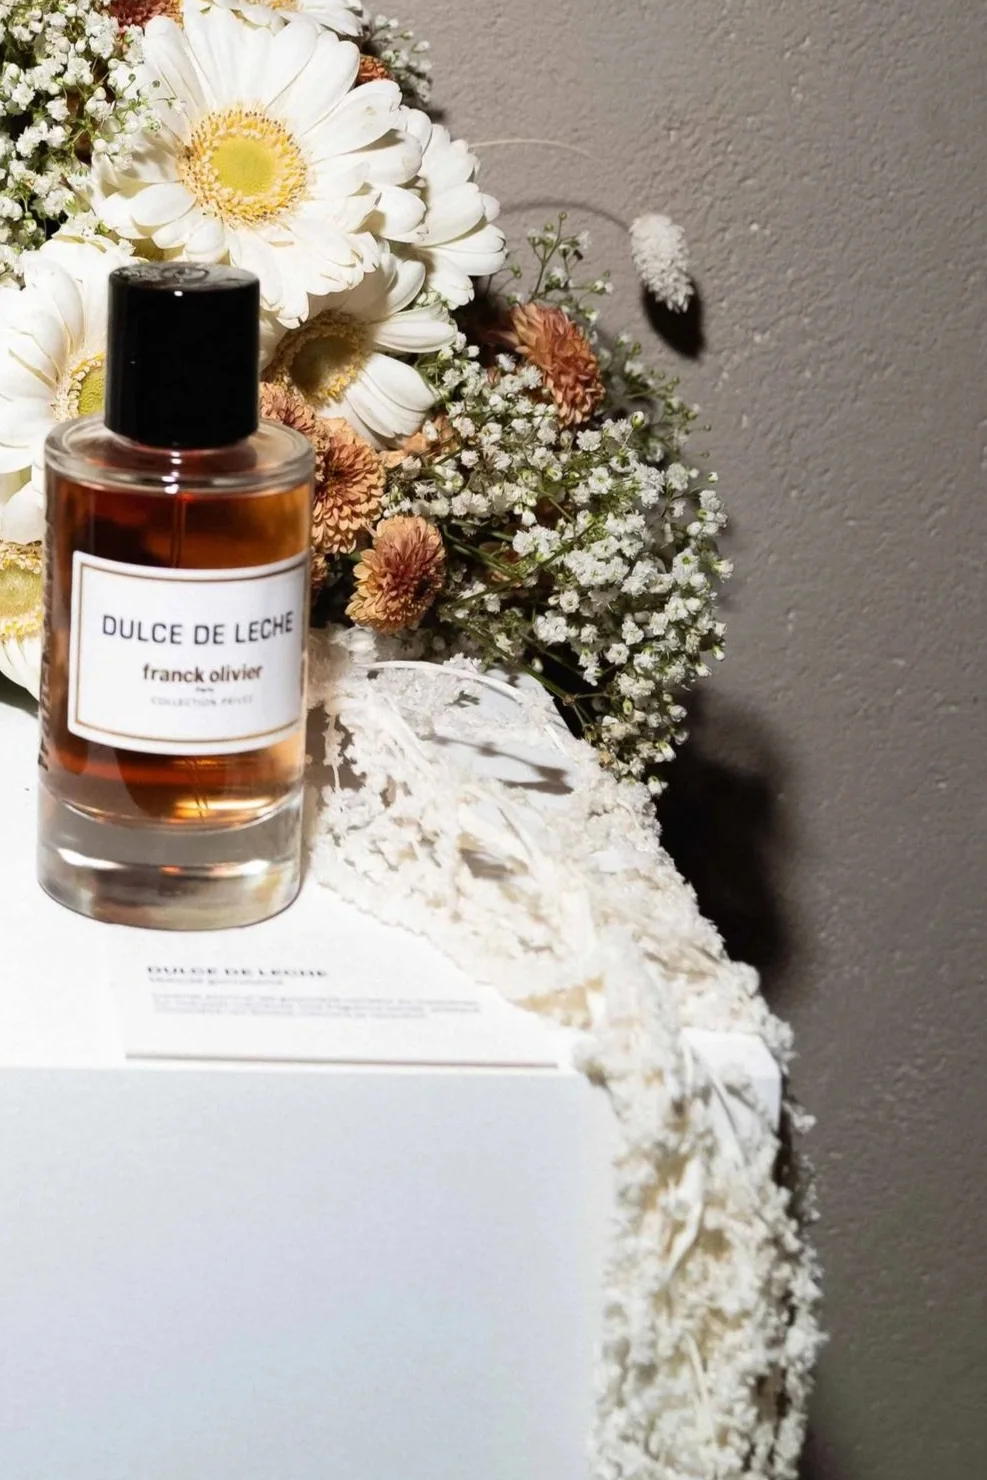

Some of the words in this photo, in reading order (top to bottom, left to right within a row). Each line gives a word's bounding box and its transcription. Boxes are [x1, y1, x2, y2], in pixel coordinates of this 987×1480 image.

[102, 615, 183, 645] DULCE
[194, 623, 225, 645] DE
[235, 611, 294, 643] LECHE
[143, 663, 204, 683] franck
[210, 663, 263, 683] olivier
[146, 965, 218, 975] DULCE
[224, 967, 252, 976] DE
